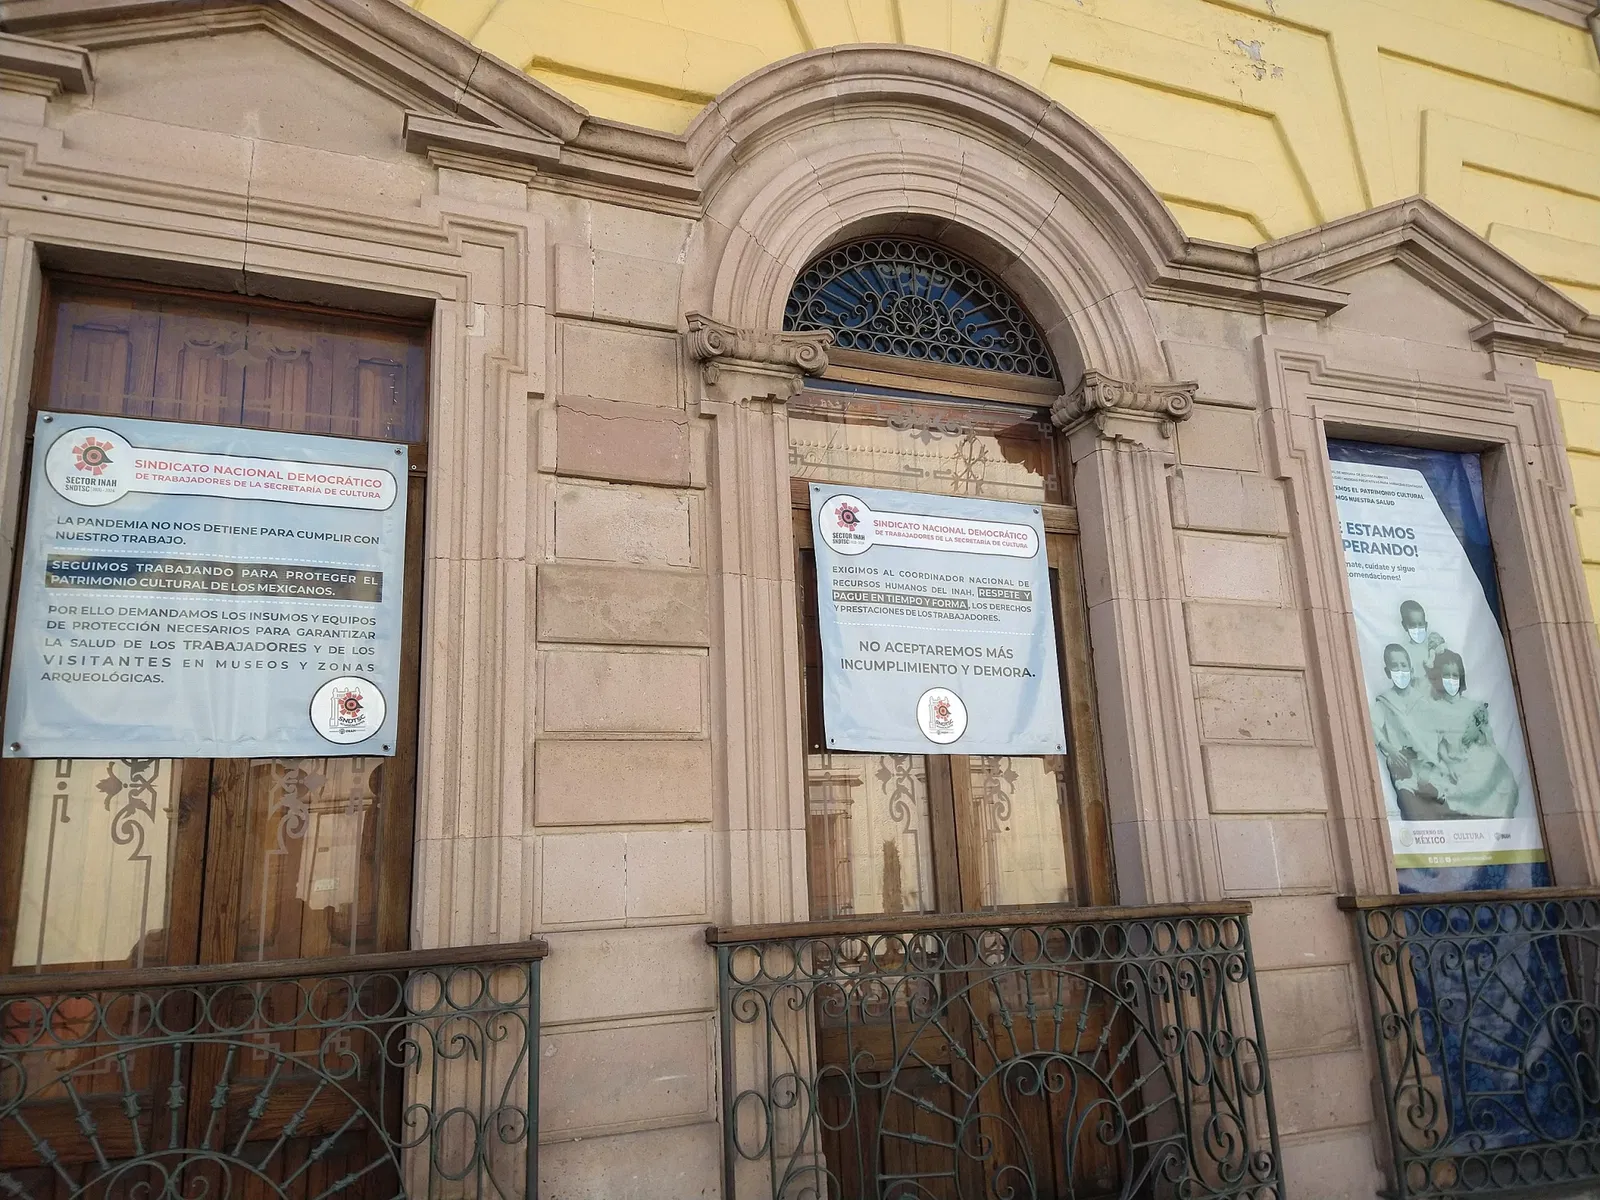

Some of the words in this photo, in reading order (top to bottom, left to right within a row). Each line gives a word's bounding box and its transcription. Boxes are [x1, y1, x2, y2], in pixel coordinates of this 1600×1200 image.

[66, 476, 97, 486] SECTOR
[98, 478, 117, 487] INAH
[135, 459, 210, 473] SINDICATO
[213, 465, 283, 480] NACIONAL
[287, 472, 382, 488] DEMOCRÁTICO
[151, 474, 231, 486] TRABAJADORES
[234, 480, 247, 488] DE
[264, 482, 322, 494] SECRETARÍA
[340, 490, 380, 499] CULTURA
[1360, 489, 1395, 497] PATRIMONIO
[1397, 492, 1425, 500] CULTURAL
[1349, 496, 1375, 504] NUESTRA
[56, 531, 120, 543] NUESTRO
[122, 534, 187, 545] TRABAJO.
[57, 516, 73, 525] LA
[77, 517, 148, 530] PANDEMIA
[152, 522, 171, 530] NO
[174, 522, 200, 531] NOS
[204, 524, 258, 536] DETIENE
[260, 528, 294, 538] PARA
[297, 530, 352, 543] CUMPLIR
[354, 535, 380, 545] CON
[873, 520, 920, 530] SINDICATO
[922, 524, 966, 535] NACIONAL
[968, 528, 1028, 540] DEMOCRÁTICO
[1346, 522, 1415, 540] ESTAMOS
[885, 531, 934, 540] TRABAJADORES
[954, 537, 991, 545] SECRETARÍA
[1002, 541, 1028, 549] CULTURA
[52, 561, 129, 572] SEGUIMOS
[136, 563, 234, 577] TRABAJANDO
[242, 570, 278, 579] PARA
[286, 571, 356, 584] PROTEGER
[364, 576, 378, 585] EL
[832, 566, 879, 575] EXIGIMOS
[899, 570, 964, 583] COORDINADOR
[969, 577, 1014, 586] NACIONAL
[1347, 571, 1401, 581] omendaciones!
[1397, 565, 1415, 573] sigue
[50, 575, 137, 587] PATRIMONIO
[140, 578, 208, 590] CULTURAL
[211, 582, 229, 591] DE
[231, 583, 255, 592] LOS
[258, 585, 336, 596] MEXICANOS.
[833, 579, 880, 588] RECURSOS
[885, 582, 927, 592] HUMANOS
[932, 586, 947, 594] DEL
[980, 589, 1020, 599] RESPETE
[1024, 592, 1030, 600] Y
[834, 592, 868, 601] PAGUE
[871, 594, 884, 602] EN
[886, 594, 922, 605] TIEMPO
[990, 604, 1031, 613] DERECHOS
[48, 605, 77, 615] POR
[81, 606, 115, 615] ELLO
[118, 607, 218, 619] DEMANDAMOS
[222, 611, 246, 621] LOS
[250, 612, 308, 623] INSUMOS
[311, 614, 320, 623] Y
[322, 615, 377, 626] EQUIPOS
[840, 605, 904, 615] PRESTACIONES
[918, 610, 932, 618] LOS
[933, 612, 1000, 621] TRABAJADORES.
[46, 621, 66, 630] DE
[73, 621, 160, 632] PROTECCIÓN
[167, 623, 250, 635] NECESARIOS
[256, 627, 291, 636] PARA
[297, 628, 375, 640] GARANTIZAR
[45, 638, 62, 647] LA
[70, 638, 116, 648] SALUD
[124, 640, 142, 649] DE
[150, 640, 176, 650] LOS
[183, 640, 307, 653] TRABAJADORES
[314, 645, 322, 654] Y
[329, 646, 345, 655] DE
[352, 647, 375, 655] LOS
[859, 641, 881, 652] NO
[884, 642, 983, 657] ACEPTAREMOS
[986, 646, 1014, 659] MÁS
[43, 654, 172, 668] VISITANTES
[182, 659, 204, 668] EN
[216, 659, 289, 670] MUSEOS
[300, 661, 308, 670] Y
[318, 662, 375, 672] ZONAS
[841, 658, 958, 675] INCUMPLIMIENTO
[961, 665, 970, 675] Y
[974, 665, 1036, 678] DEMORA.
[41, 671, 164, 683] ARQUEOLÓGICAS.
[1415, 835, 1445, 844] MÉXICO
[1453, 832, 1485, 840] CULTURA
